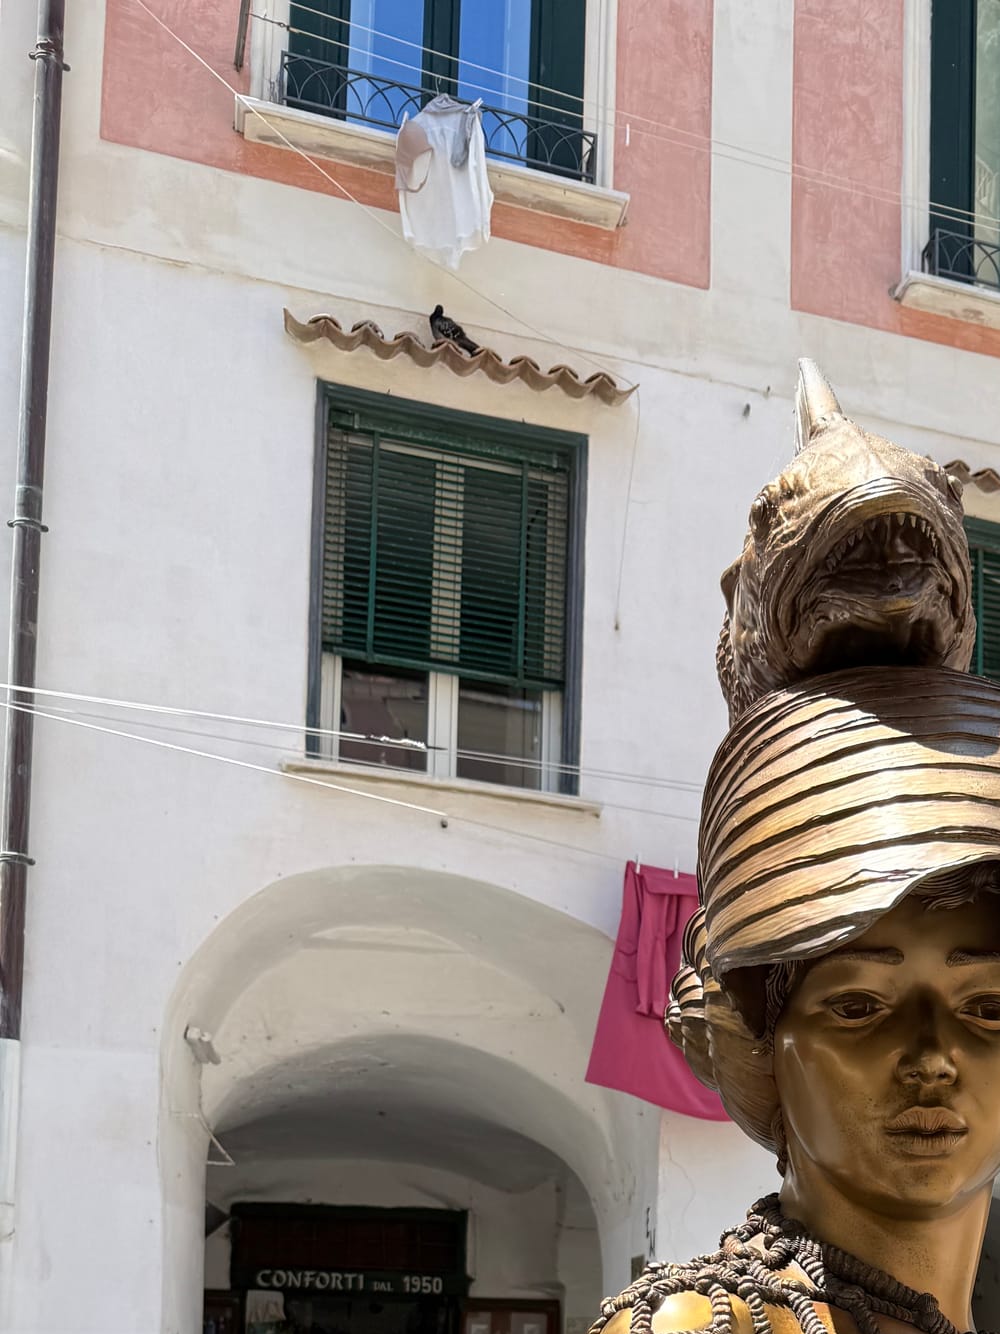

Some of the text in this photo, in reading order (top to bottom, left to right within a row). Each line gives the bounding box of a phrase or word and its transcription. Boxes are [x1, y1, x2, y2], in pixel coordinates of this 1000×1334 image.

[256, 1269, 443, 1294] CONFORTI DAL 1950
